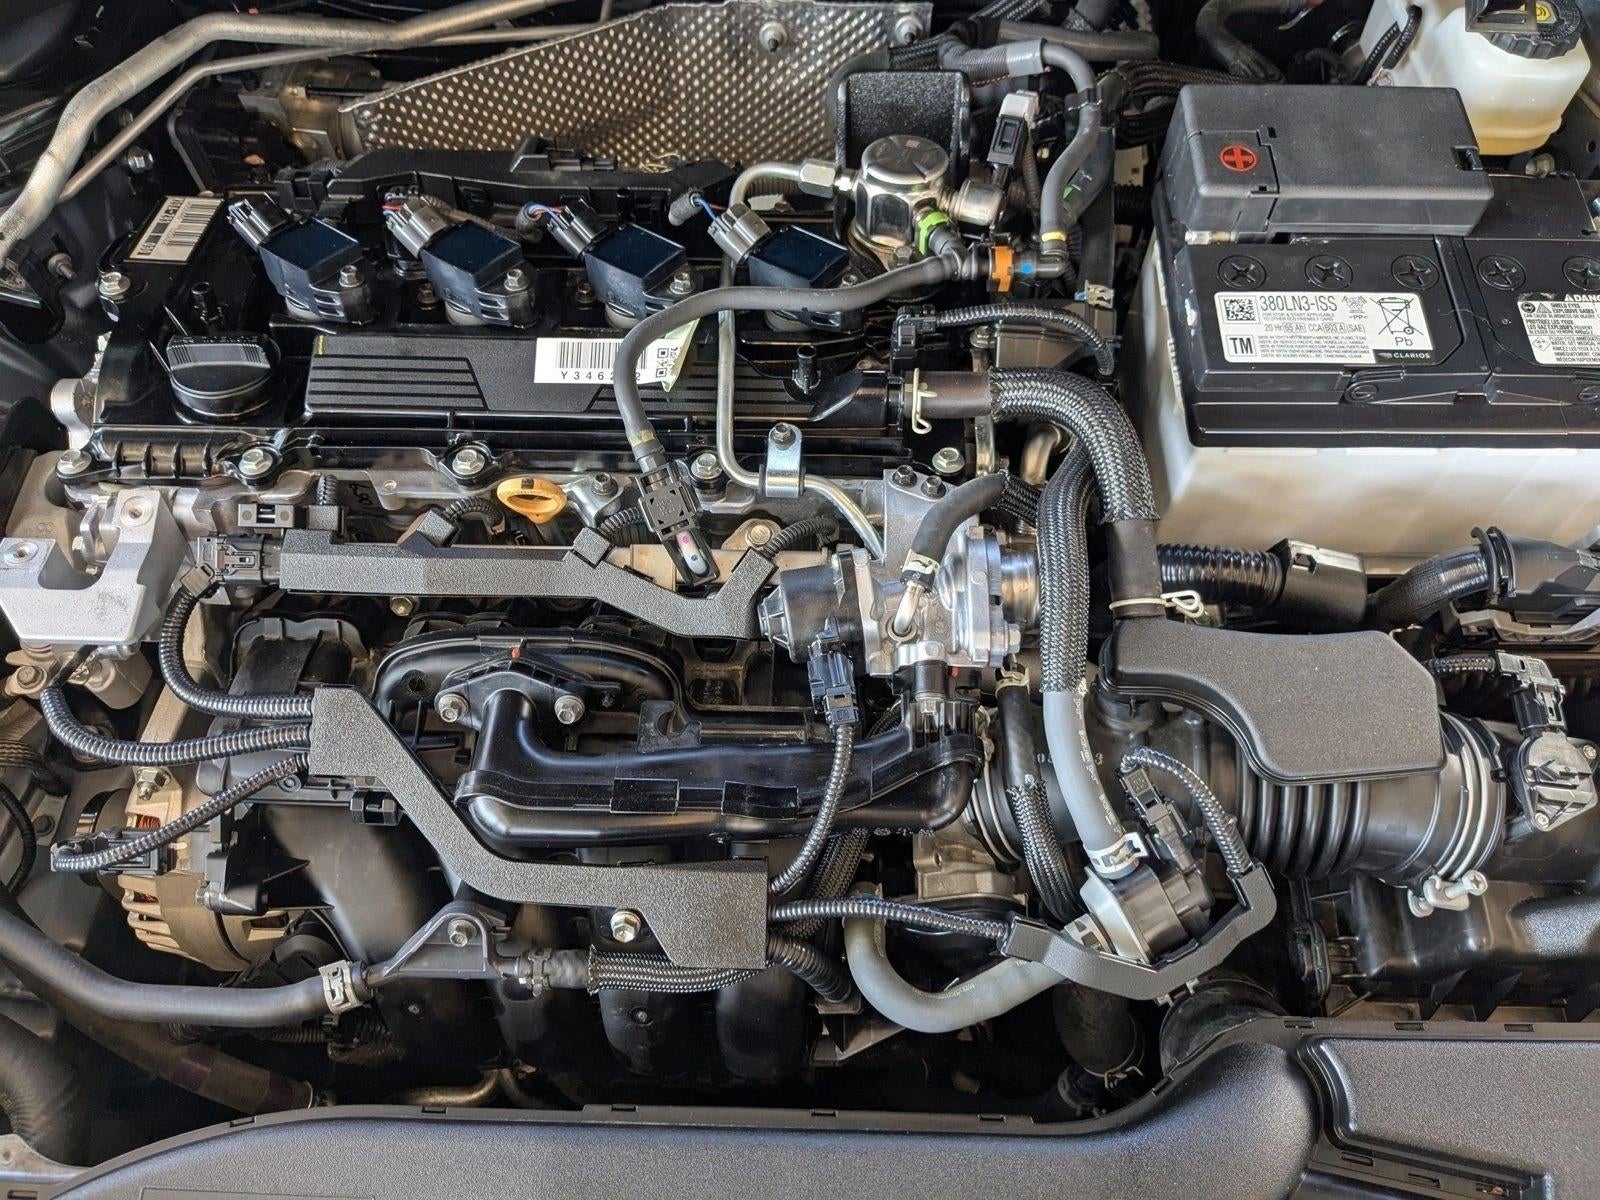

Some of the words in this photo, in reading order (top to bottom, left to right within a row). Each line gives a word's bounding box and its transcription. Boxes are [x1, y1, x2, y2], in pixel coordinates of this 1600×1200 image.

[1260, 295, 1338, 311] 380LN3-ISS
[1264, 324, 1272, 332] 20
[1308, 324, 1323, 332] CCA
[1346, 324, 1366, 332] (SAE)
[1229, 337, 1253, 354] TM
[1394, 336, 1413, 346] Pb
[561, 371, 641, 380] Y34622
